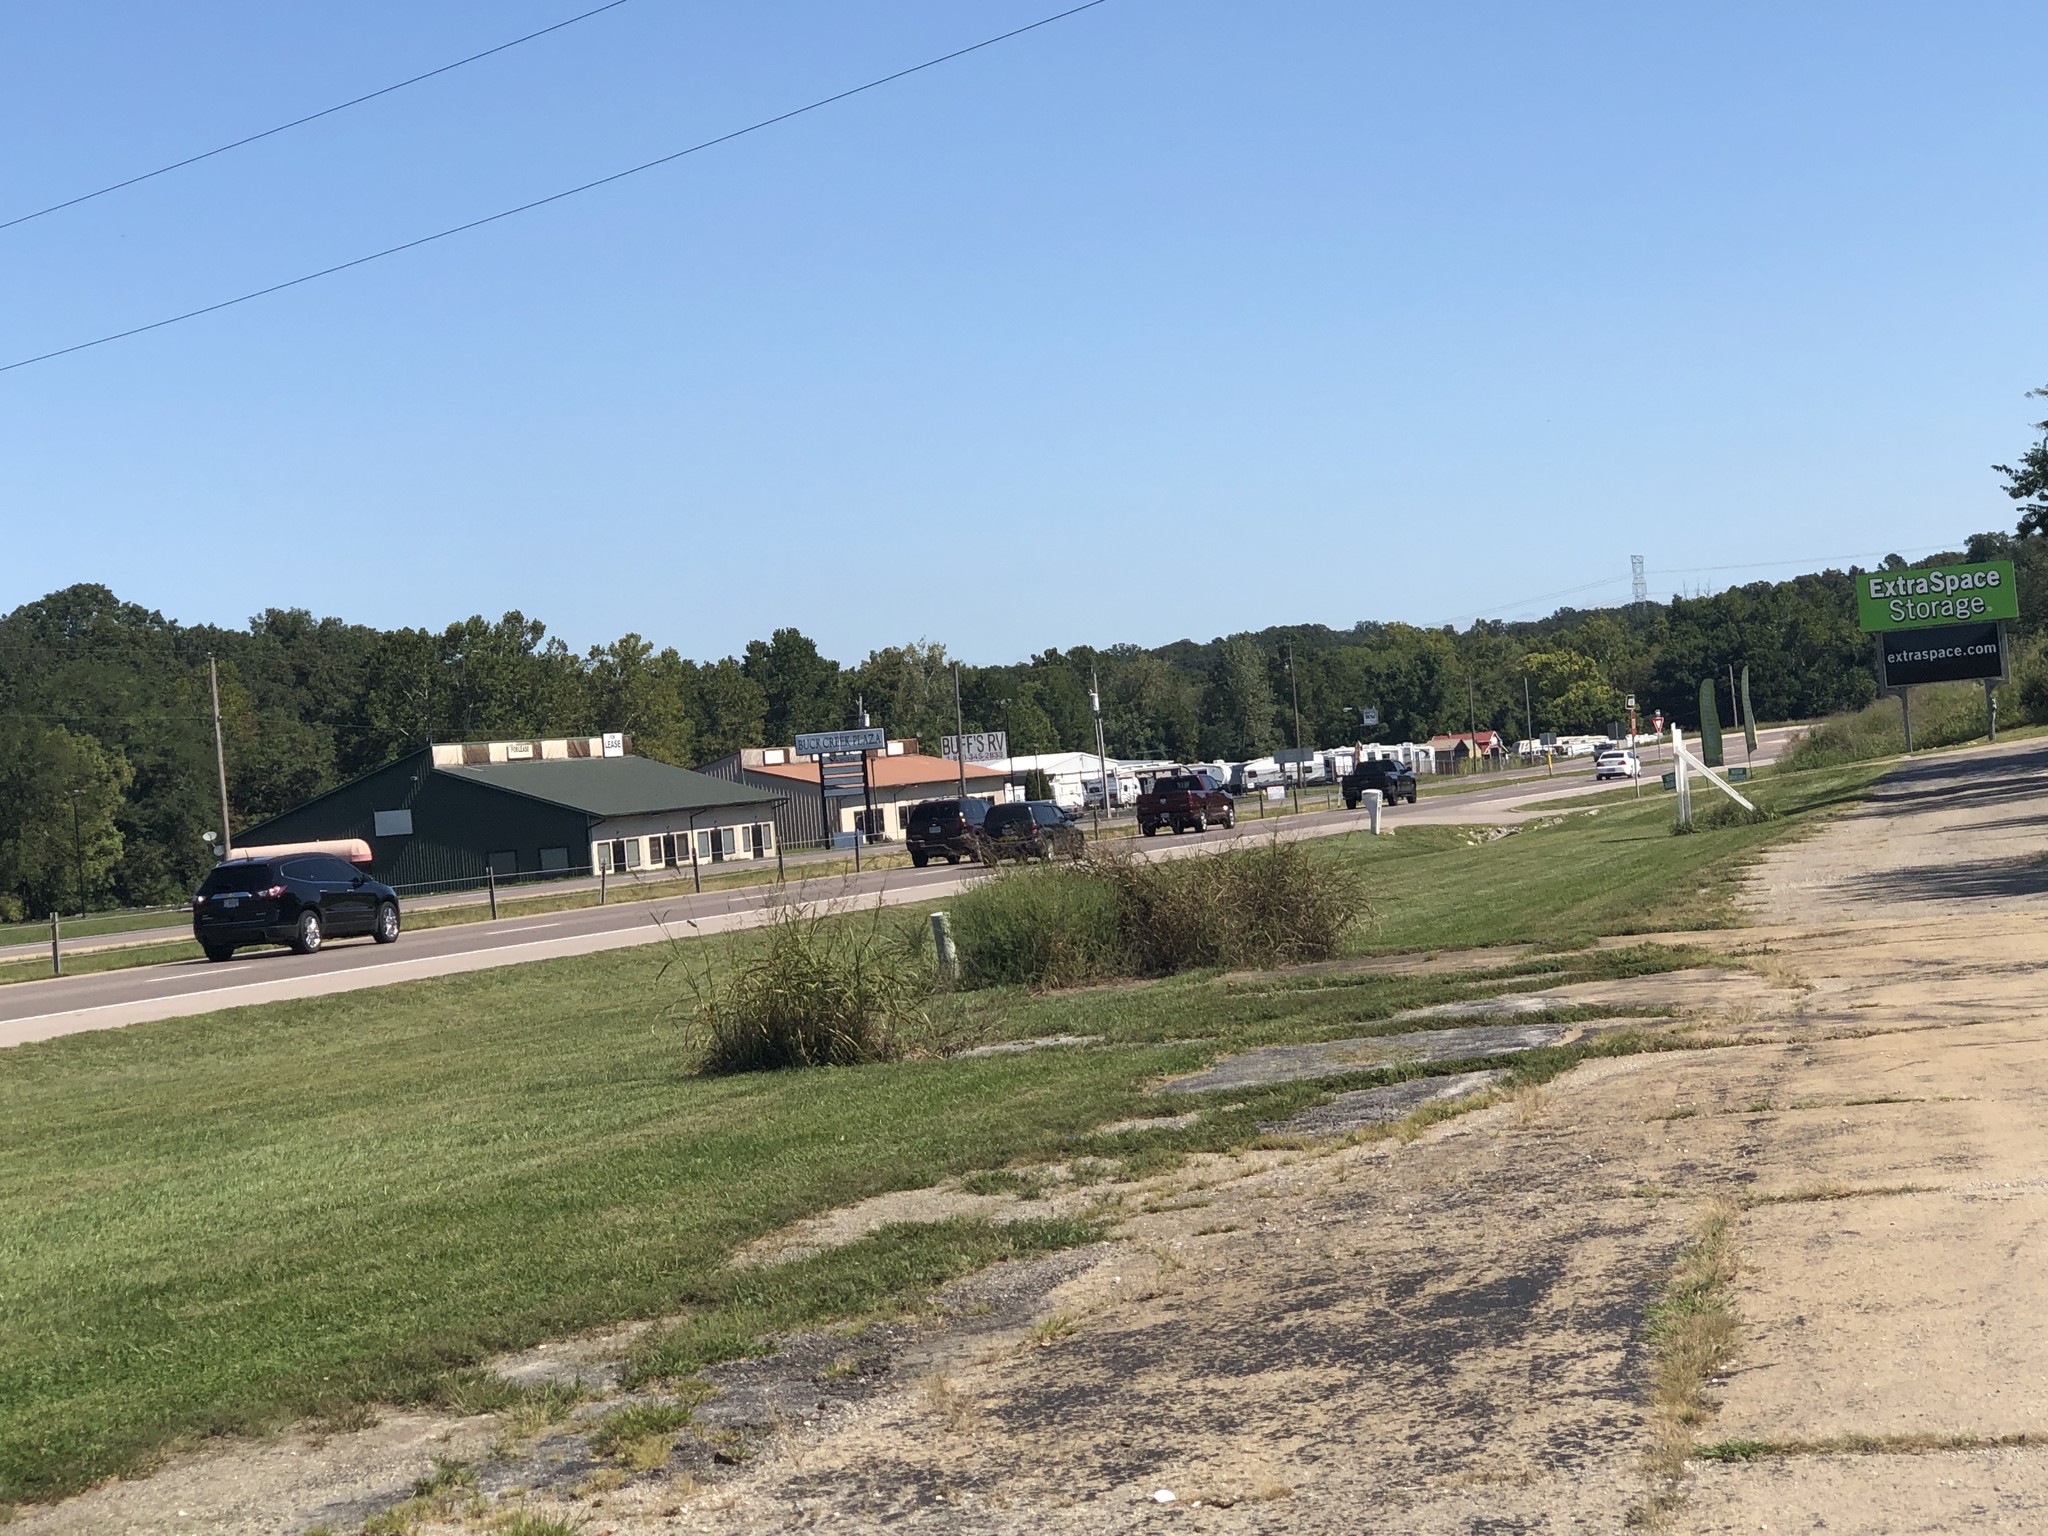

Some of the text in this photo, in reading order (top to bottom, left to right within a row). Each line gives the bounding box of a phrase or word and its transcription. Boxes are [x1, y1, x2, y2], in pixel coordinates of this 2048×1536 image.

[1889, 596, 1985, 622] Storage
[1887, 643, 1998, 664] extraspace.com
[605, 740, 621, 749] LEASE
[798, 733, 882, 751] BUCK CREEK PLAZA
[988, 733, 1003, 751] RV
